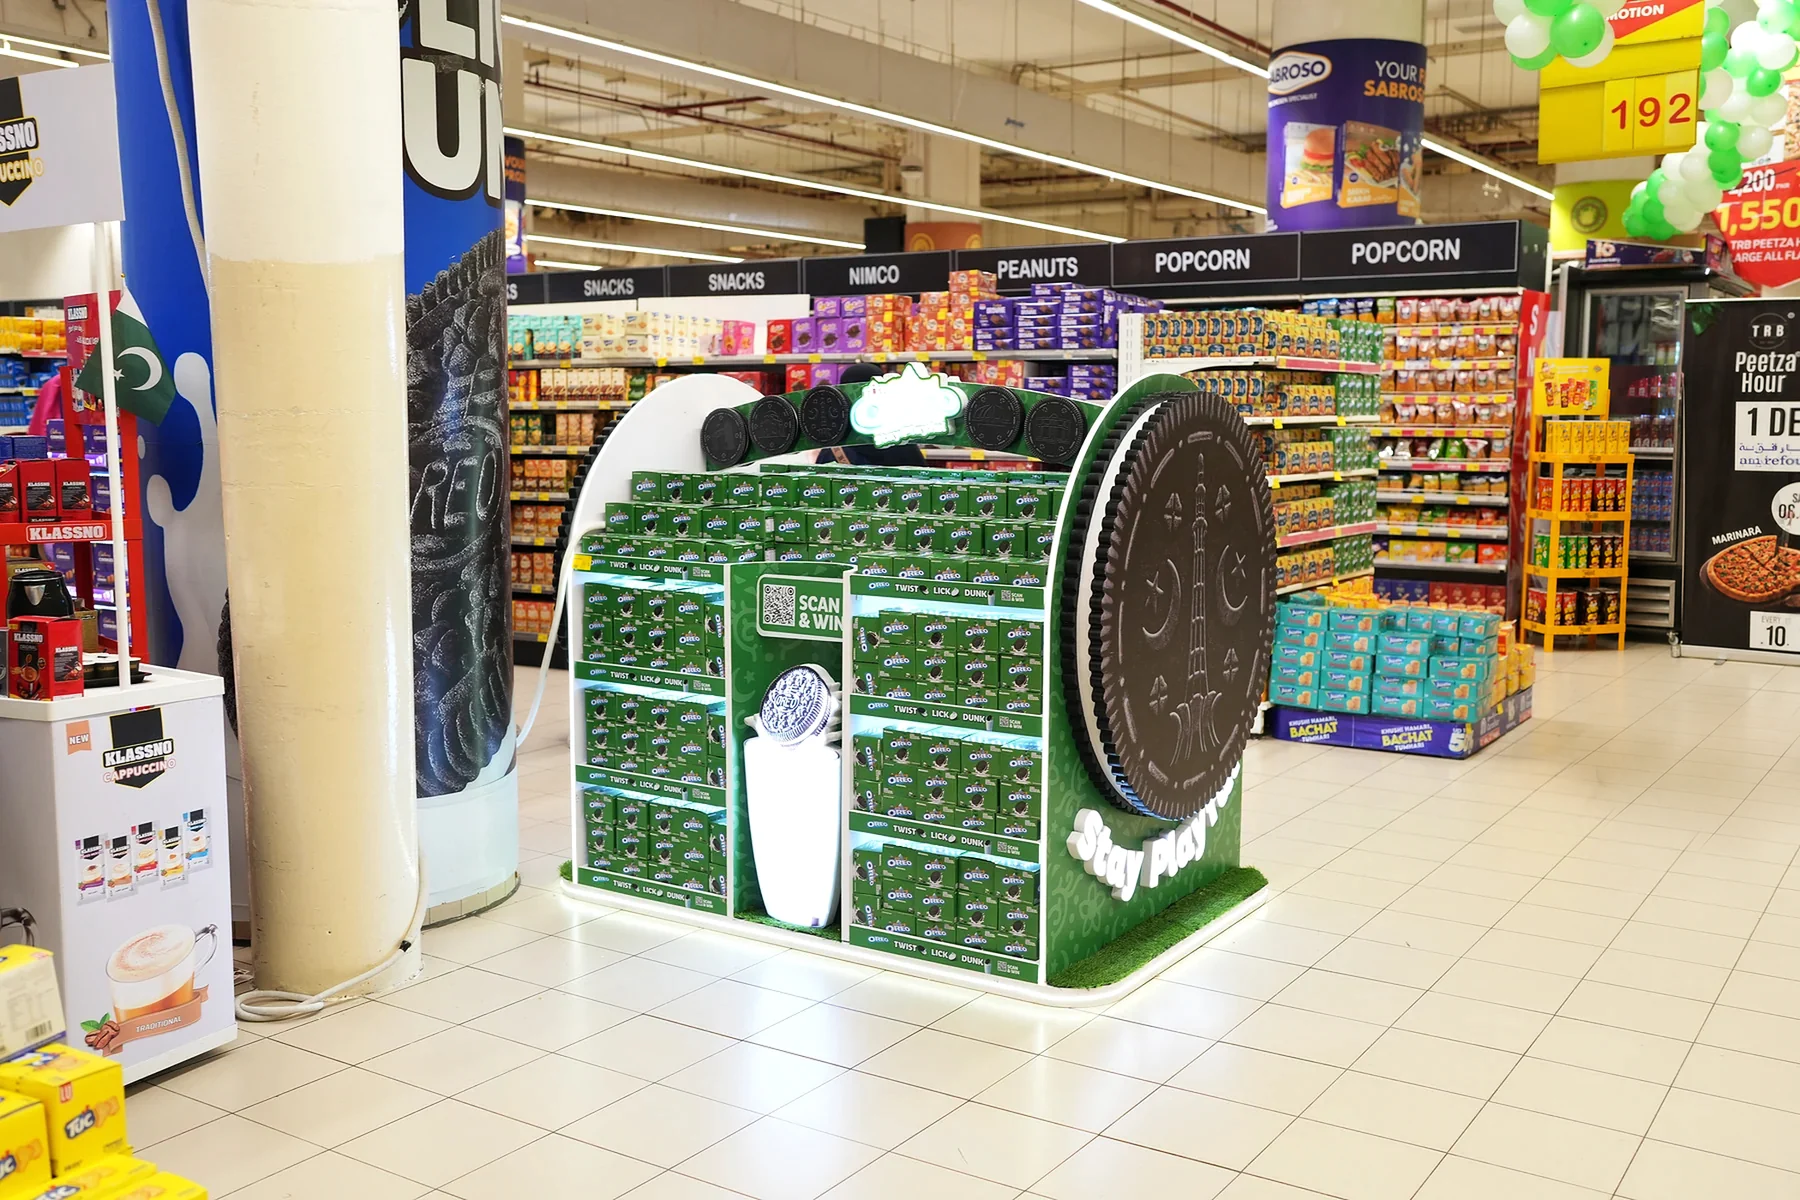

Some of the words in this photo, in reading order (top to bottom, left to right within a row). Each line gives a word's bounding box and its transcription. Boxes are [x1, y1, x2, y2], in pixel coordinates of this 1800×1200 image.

[1375, 60, 1417, 82] YOUR
[1611, 93, 1691, 130] 192
[1352, 238, 1460, 264] POPCORN
[1731, 240, 1751, 250] TRB
[1753, 238, 1794, 249] PEETZA
[1155, 248, 1250, 273] POPCORN
[1764, 252, 1784, 261] ALL
[849, 264, 900, 286] NIMCO
[997, 257, 1078, 279] PEANUTS
[583, 277, 634, 296] SNACKS
[708, 271, 765, 292] SNACKS
[1752, 325, 1784, 337] TRB
[1735, 351, 1796, 372] Peetza
[1742, 372, 1786, 393] Hour
[1748, 408, 1758, 436] 1
[29, 526, 104, 540] KLASSNO
[1712, 526, 1762, 545] MARINARA
[868, 581, 890, 590] OREO
[895, 584, 919, 593] TWIST
[933, 587, 950, 595] LICK
[964, 589, 987, 598] DUNK
[800, 595, 840, 613] SCAN
[799, 613, 812, 629] &
[814, 614, 843, 632] WIN
[14, 633, 43, 643] KLASSNO
[610, 671, 629, 680] TWIST
[894, 706, 917, 715] TWIST
[932, 710, 949, 719] LICK
[962, 713, 985, 723] DUNK
[1311, 716, 1337, 724] HAMARI,
[69, 733, 89, 745] NEW
[1290, 722, 1338, 738] BACHAT
[1302, 734, 1330, 742] TUMHARI
[1382, 730, 1433, 746] BACHAT
[104, 740, 172, 767] KLASSNO
[1395, 743, 1424, 751] TUMHARI
[103, 759, 176, 783] CAPPUCCINO
[610, 776, 628, 785] TWIST
[664, 785, 682, 793] DUNK
[893, 825, 917, 835] TWIST
[931, 832, 949, 840] LICK
[961, 837, 984, 847] DUNK
[1067, 808, 1144, 902] Stay
[613, 880, 632, 889] TWIST
[643, 886, 657, 894] LICK
[667, 891, 685, 900] DUNK
[894, 941, 917, 951] TWIST
[931, 949, 949, 959] LICK
[961, 955, 984, 966] DUNK
[136, 1016, 181, 1033] TRADITIONAL
